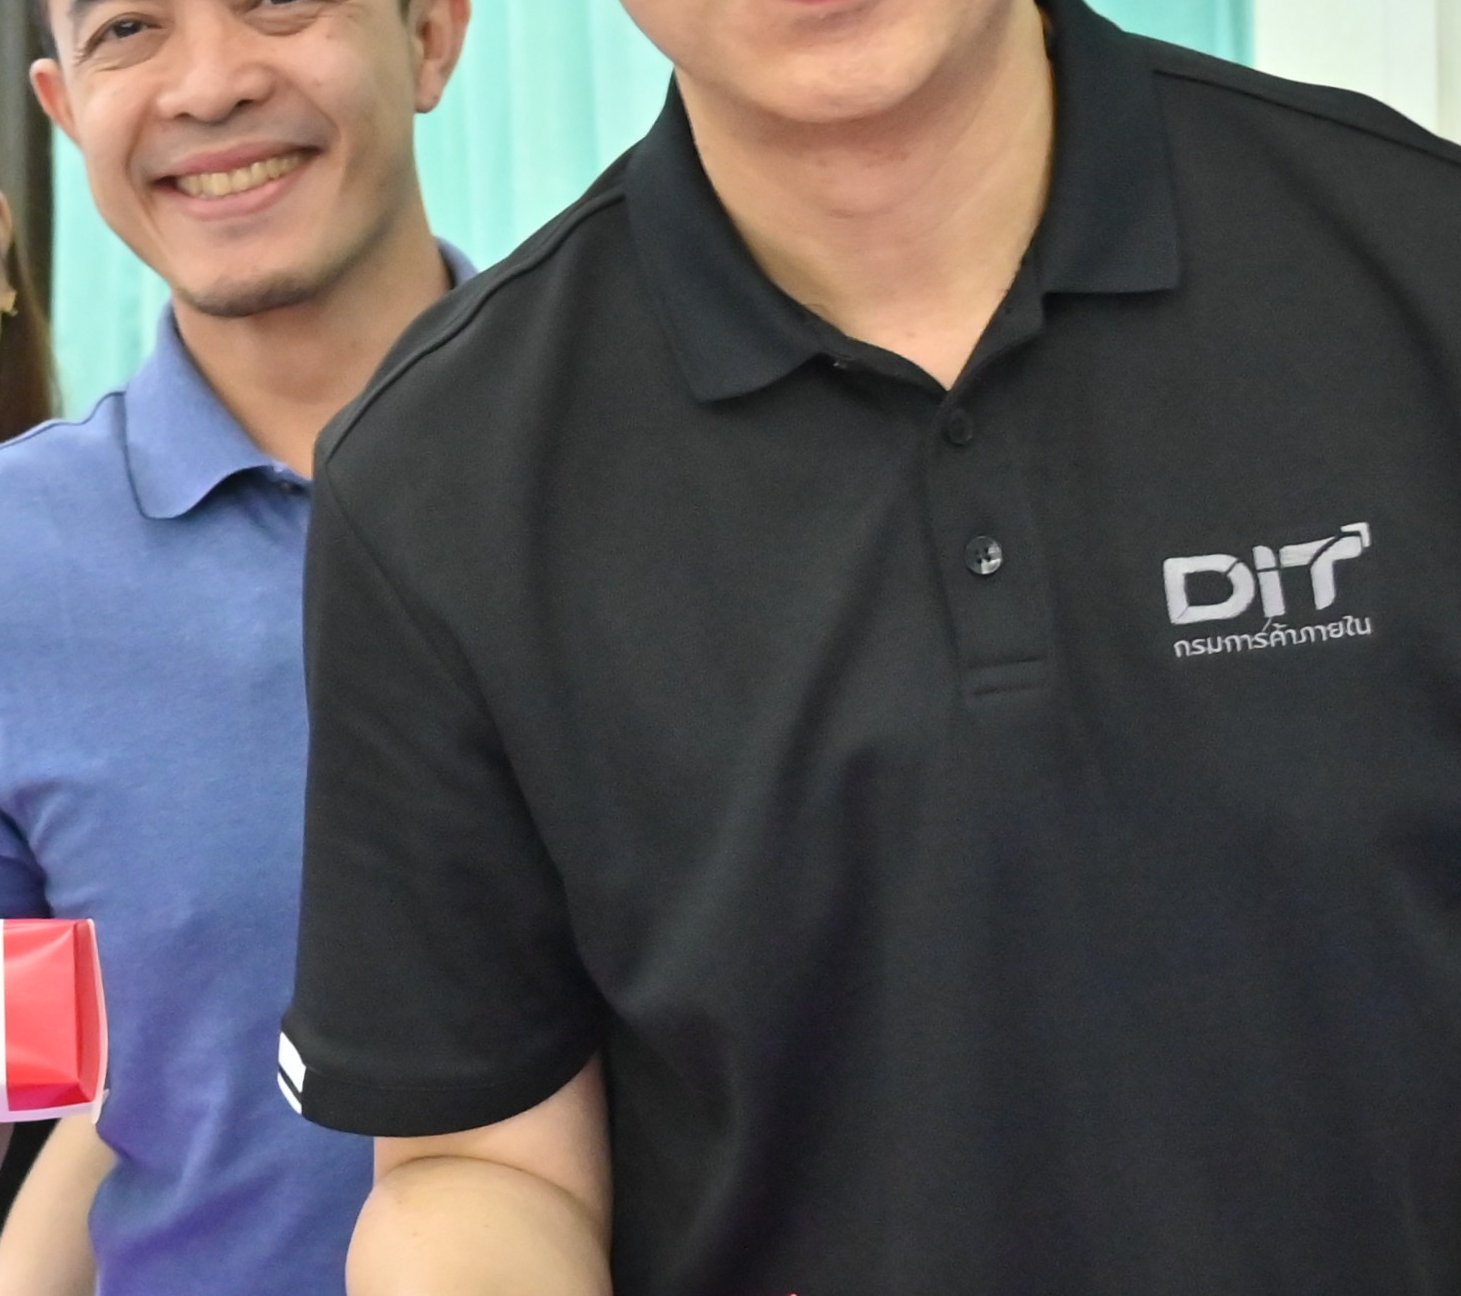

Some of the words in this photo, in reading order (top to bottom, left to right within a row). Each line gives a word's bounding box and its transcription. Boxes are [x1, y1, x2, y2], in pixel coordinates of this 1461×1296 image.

[1173, 616, 1372, 658] กรมการค้าภายใน
